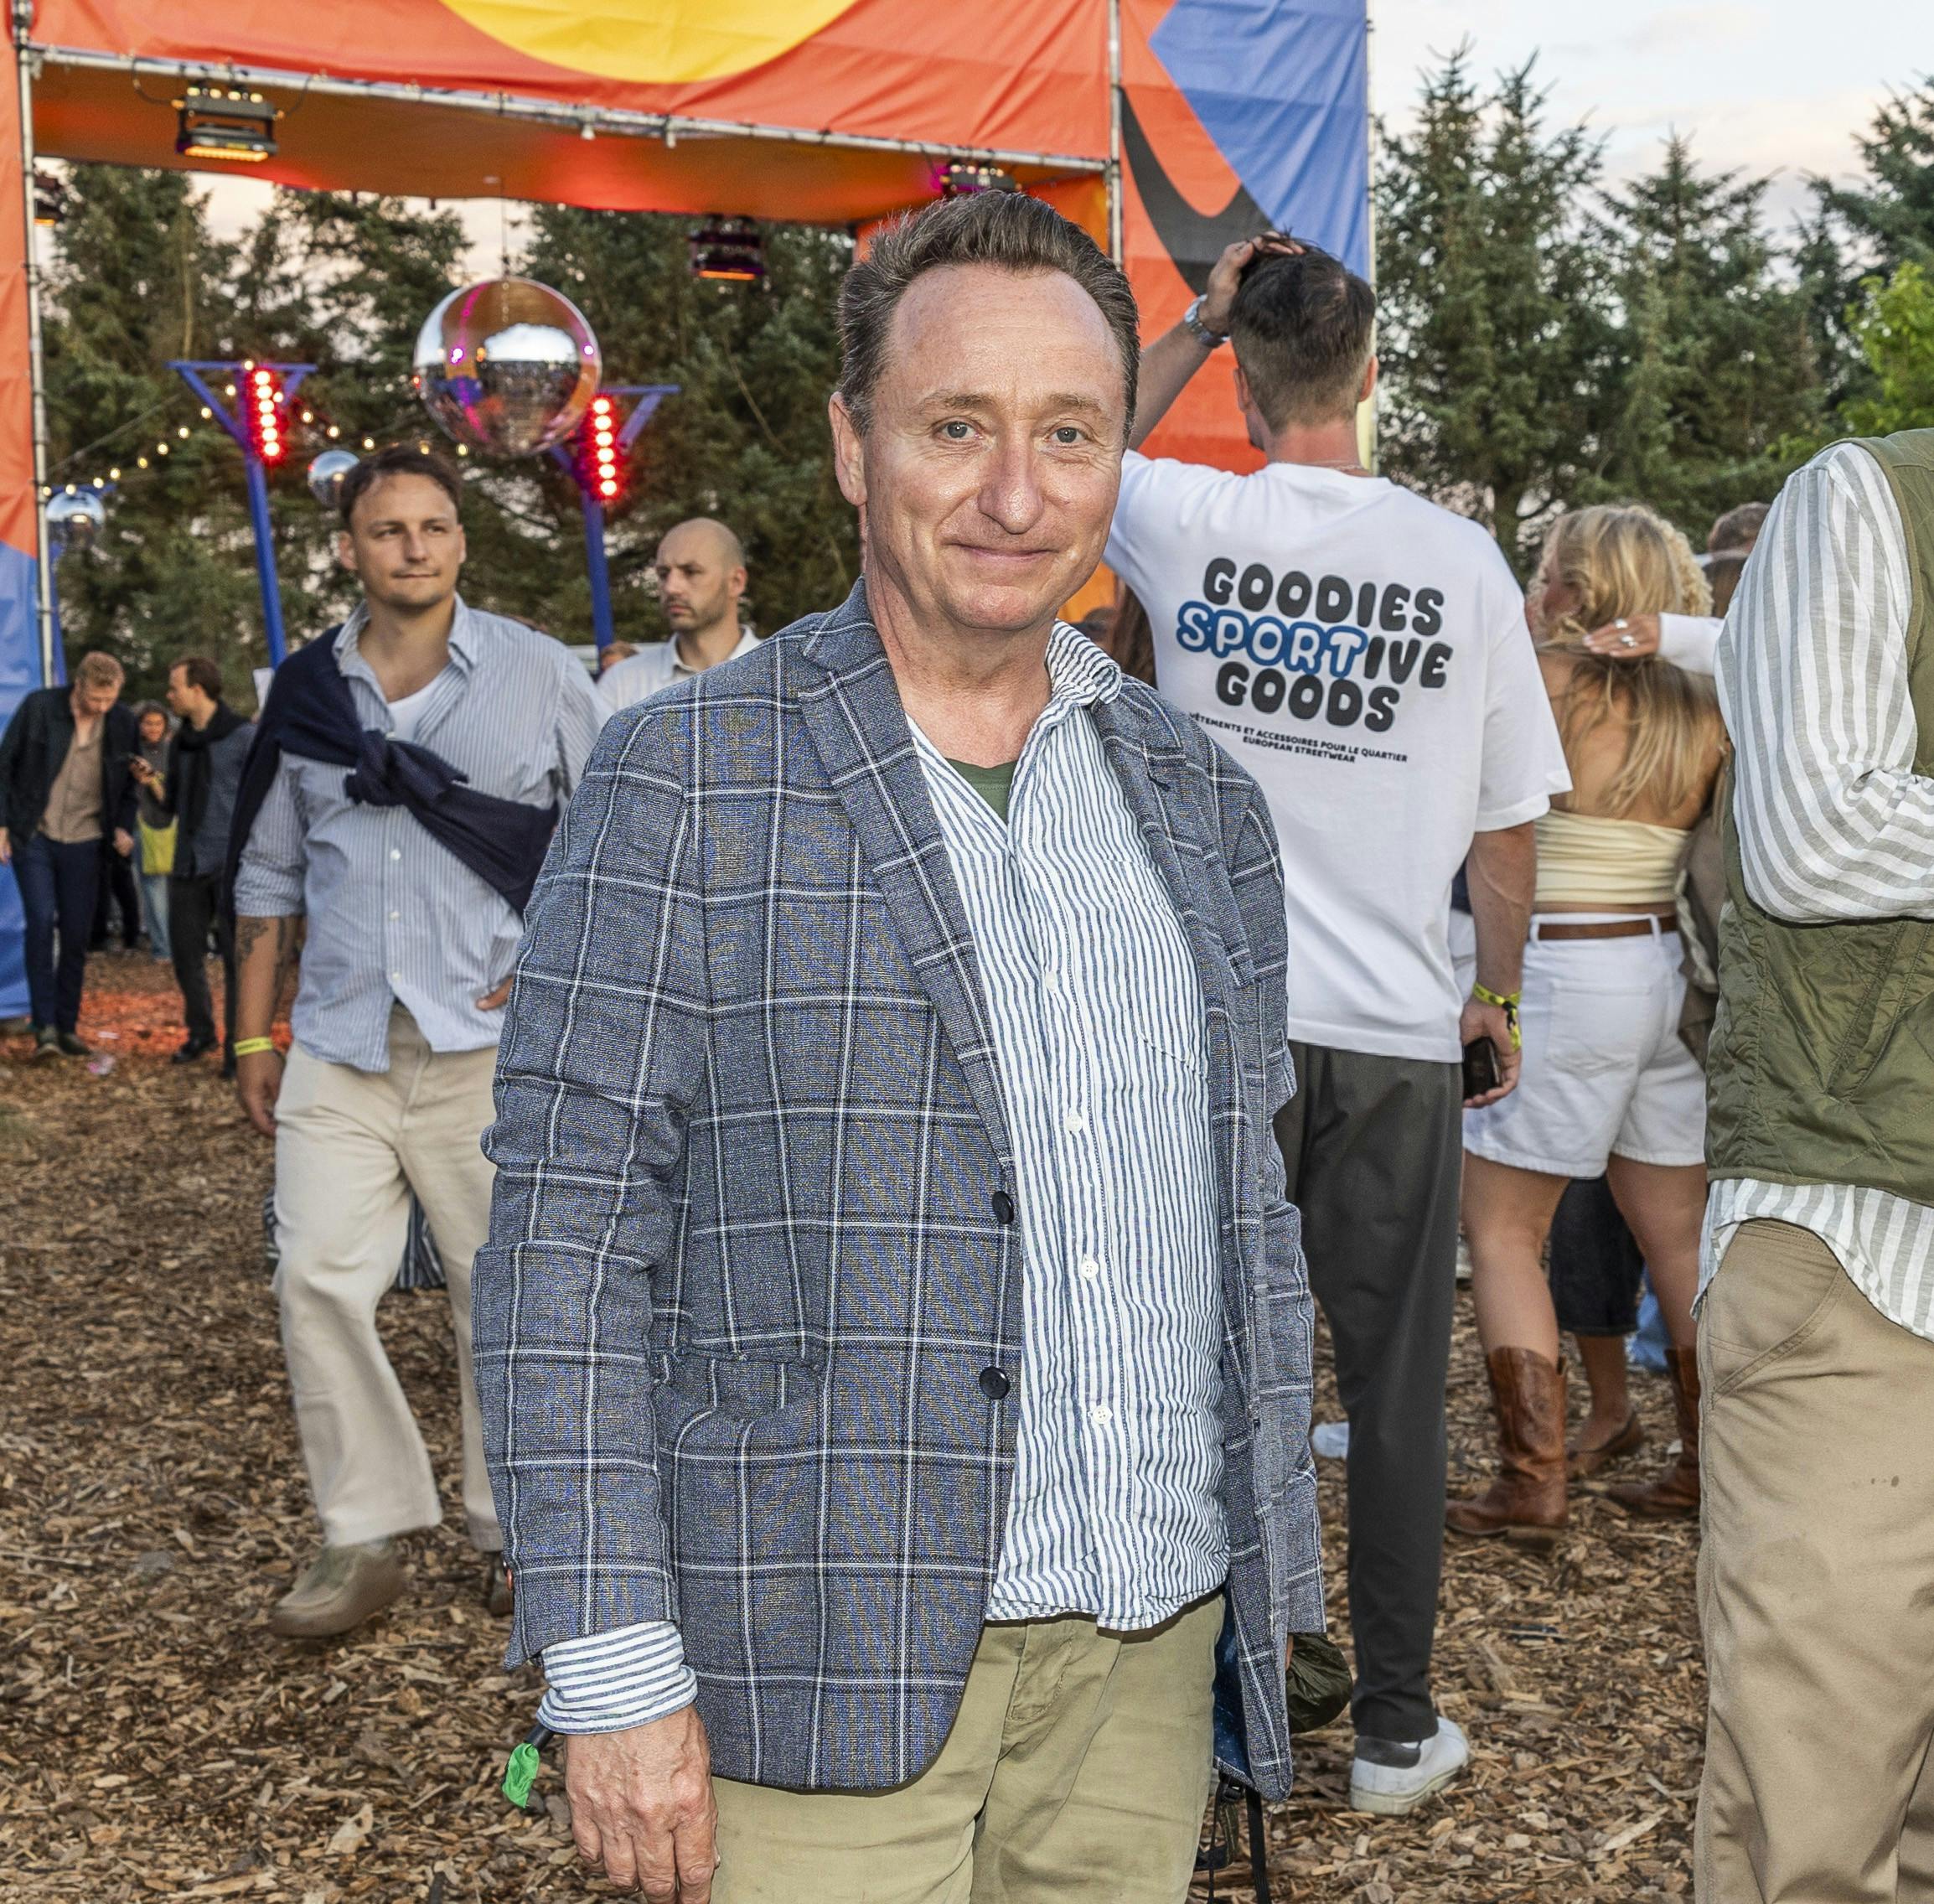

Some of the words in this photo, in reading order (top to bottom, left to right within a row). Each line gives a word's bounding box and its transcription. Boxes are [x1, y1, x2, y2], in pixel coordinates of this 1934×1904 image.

[1203, 557, 1444, 636] GOODIES
[1176, 601, 1453, 688] SPORTIVE
[1216, 661, 1400, 732] GOODS
[1243, 737, 1292, 752] EUROPEAN
[1295, 746, 1355, 763] STREETWEAR
[1244, 726, 1255, 735] ET
[1257, 730, 1318, 748] ACCESSOIRES
[1321, 741, 1346, 753] POUR
[1349, 745, 1358, 754] LE
[1361, 748, 1408, 762] QUARTIER
